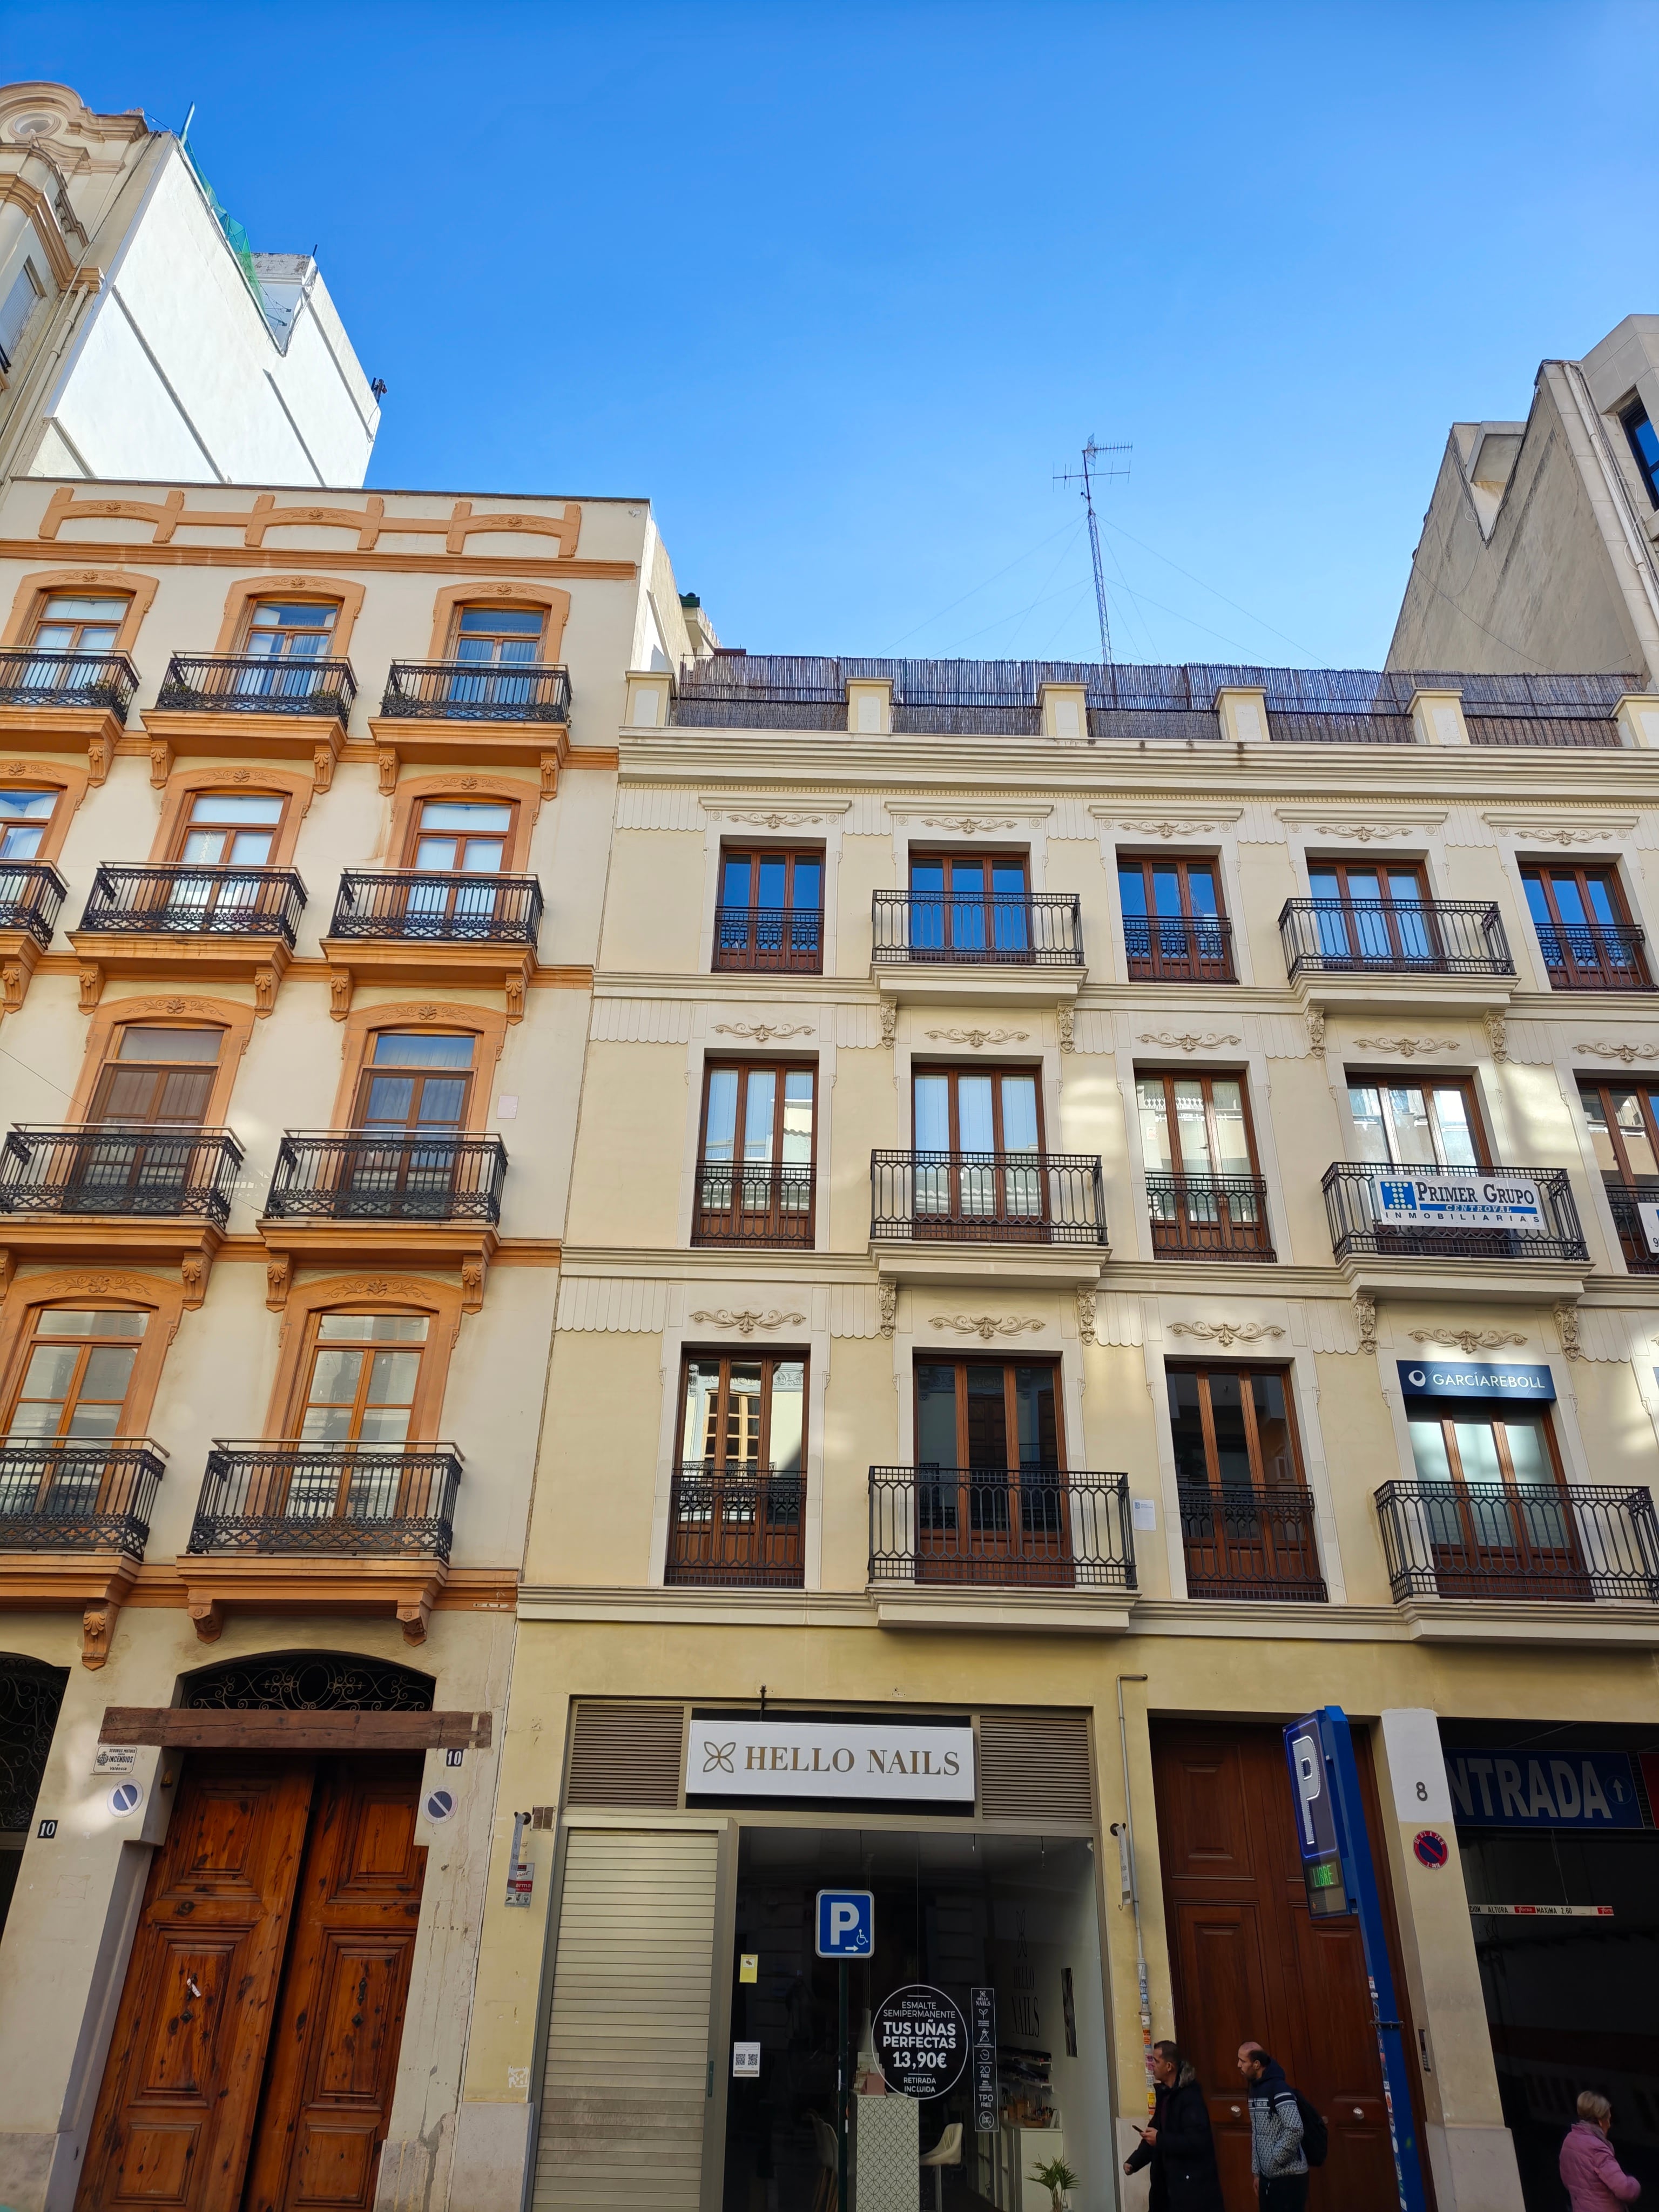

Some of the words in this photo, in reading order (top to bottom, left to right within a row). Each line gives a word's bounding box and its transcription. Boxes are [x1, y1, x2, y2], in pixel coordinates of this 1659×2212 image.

[1415, 1182, 1478, 1203] PRIMER
[1483, 1183, 1534, 1205] GRUPO
[1446, 1204, 1512, 1213] CENTROVAL
[1386, 1212, 1540, 1223] INMOBILIARIAS
[448, 1750, 462, 1765] 10
[744, 1746, 855, 1773] HELLO
[866, 1749, 960, 1776] NAILS
[1292, 1736, 1320, 1845] P
[1416, 1781, 1428, 1802] 8
[1445, 1757, 1613, 1819] NTRADA
[39, 1822, 55, 1837] 10
[1313, 1865, 1334, 1887] LIBRE
[831, 1902, 860, 1945] P
[902, 2001, 936, 2009] ESMALTE
[883, 2009, 956, 2019] SEMIPERMANENTE
[883, 2021, 912, 2035] TUS
[915, 2019, 956, 2036] UÑAS
[883, 2035, 956, 2049] PERFECTAS
[893, 2051, 947, 2070] 13,90€
[979, 2094, 994, 2102] TPO
